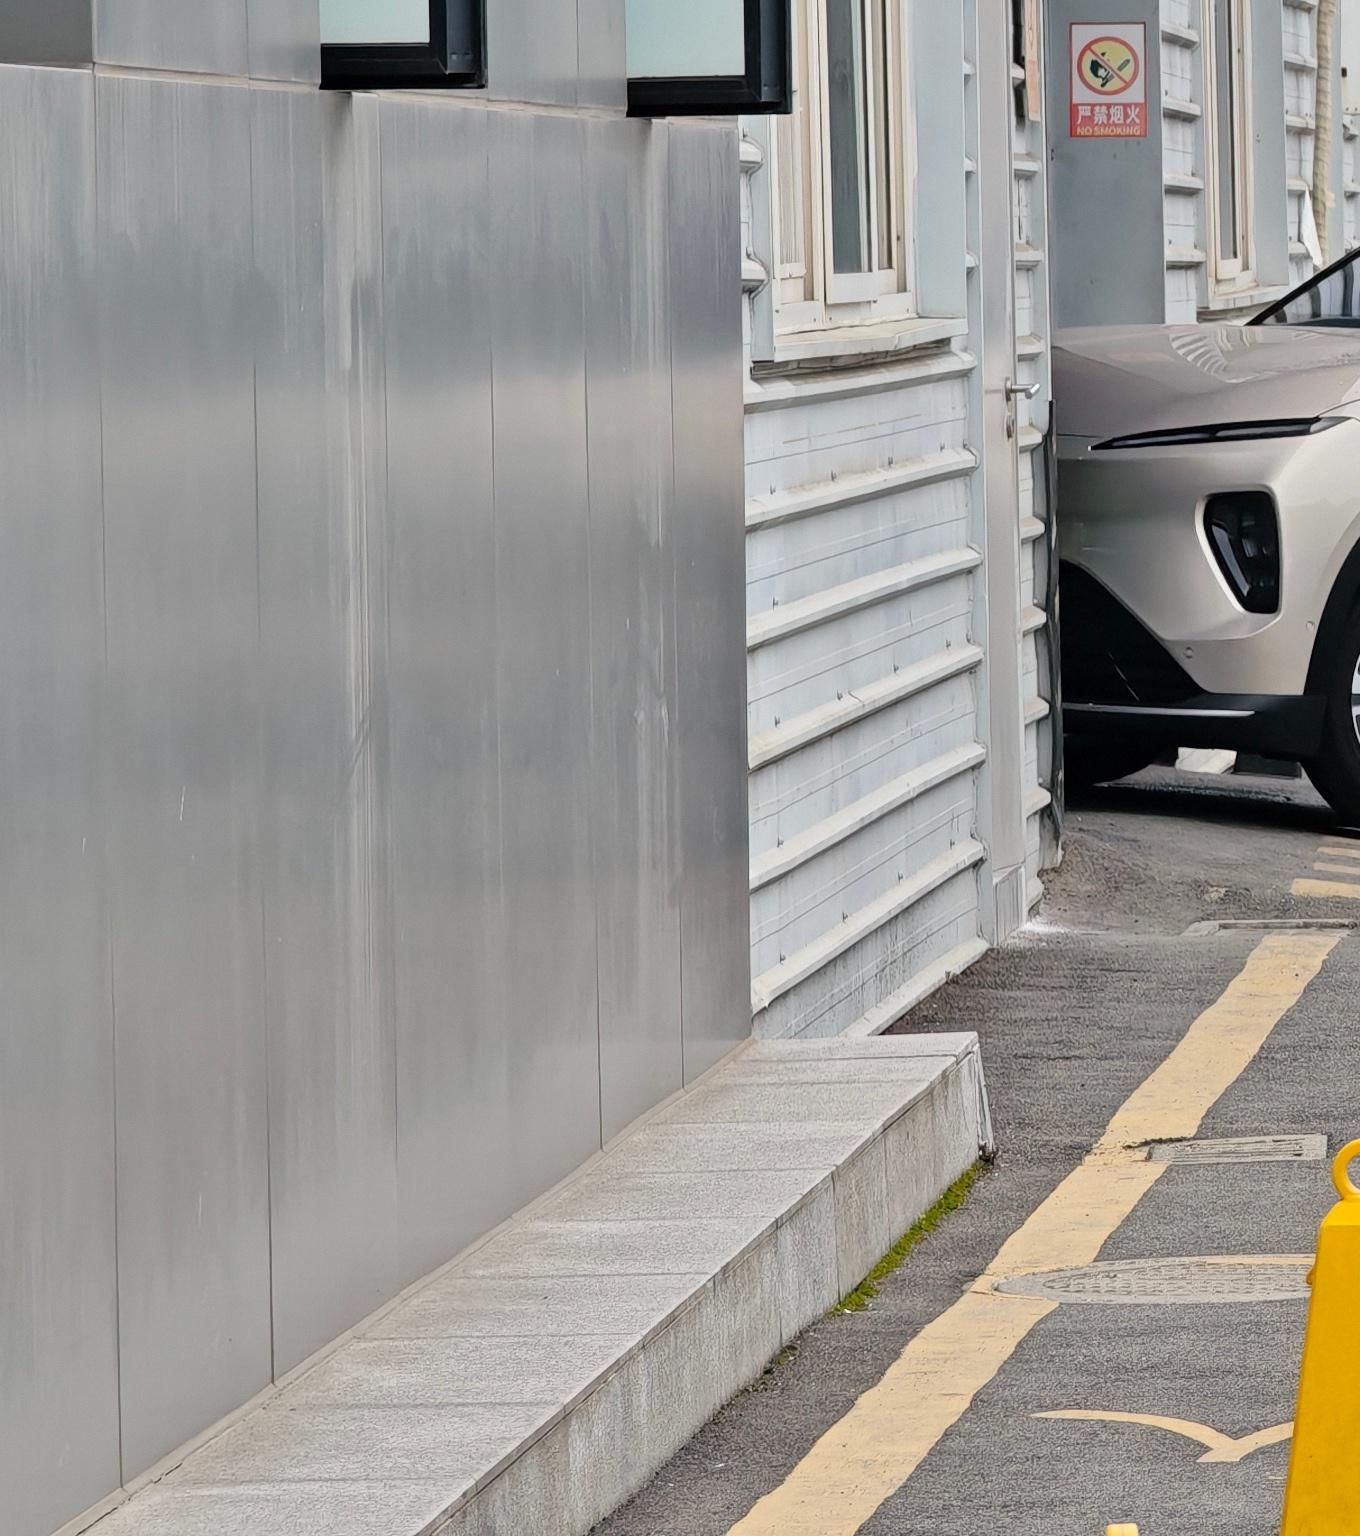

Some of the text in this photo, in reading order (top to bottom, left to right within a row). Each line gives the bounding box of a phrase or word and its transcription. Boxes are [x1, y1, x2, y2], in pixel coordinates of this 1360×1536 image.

[1076, 104, 1141, 125] 严禁烟火
[1093, 125, 1141, 136] SMOKING
